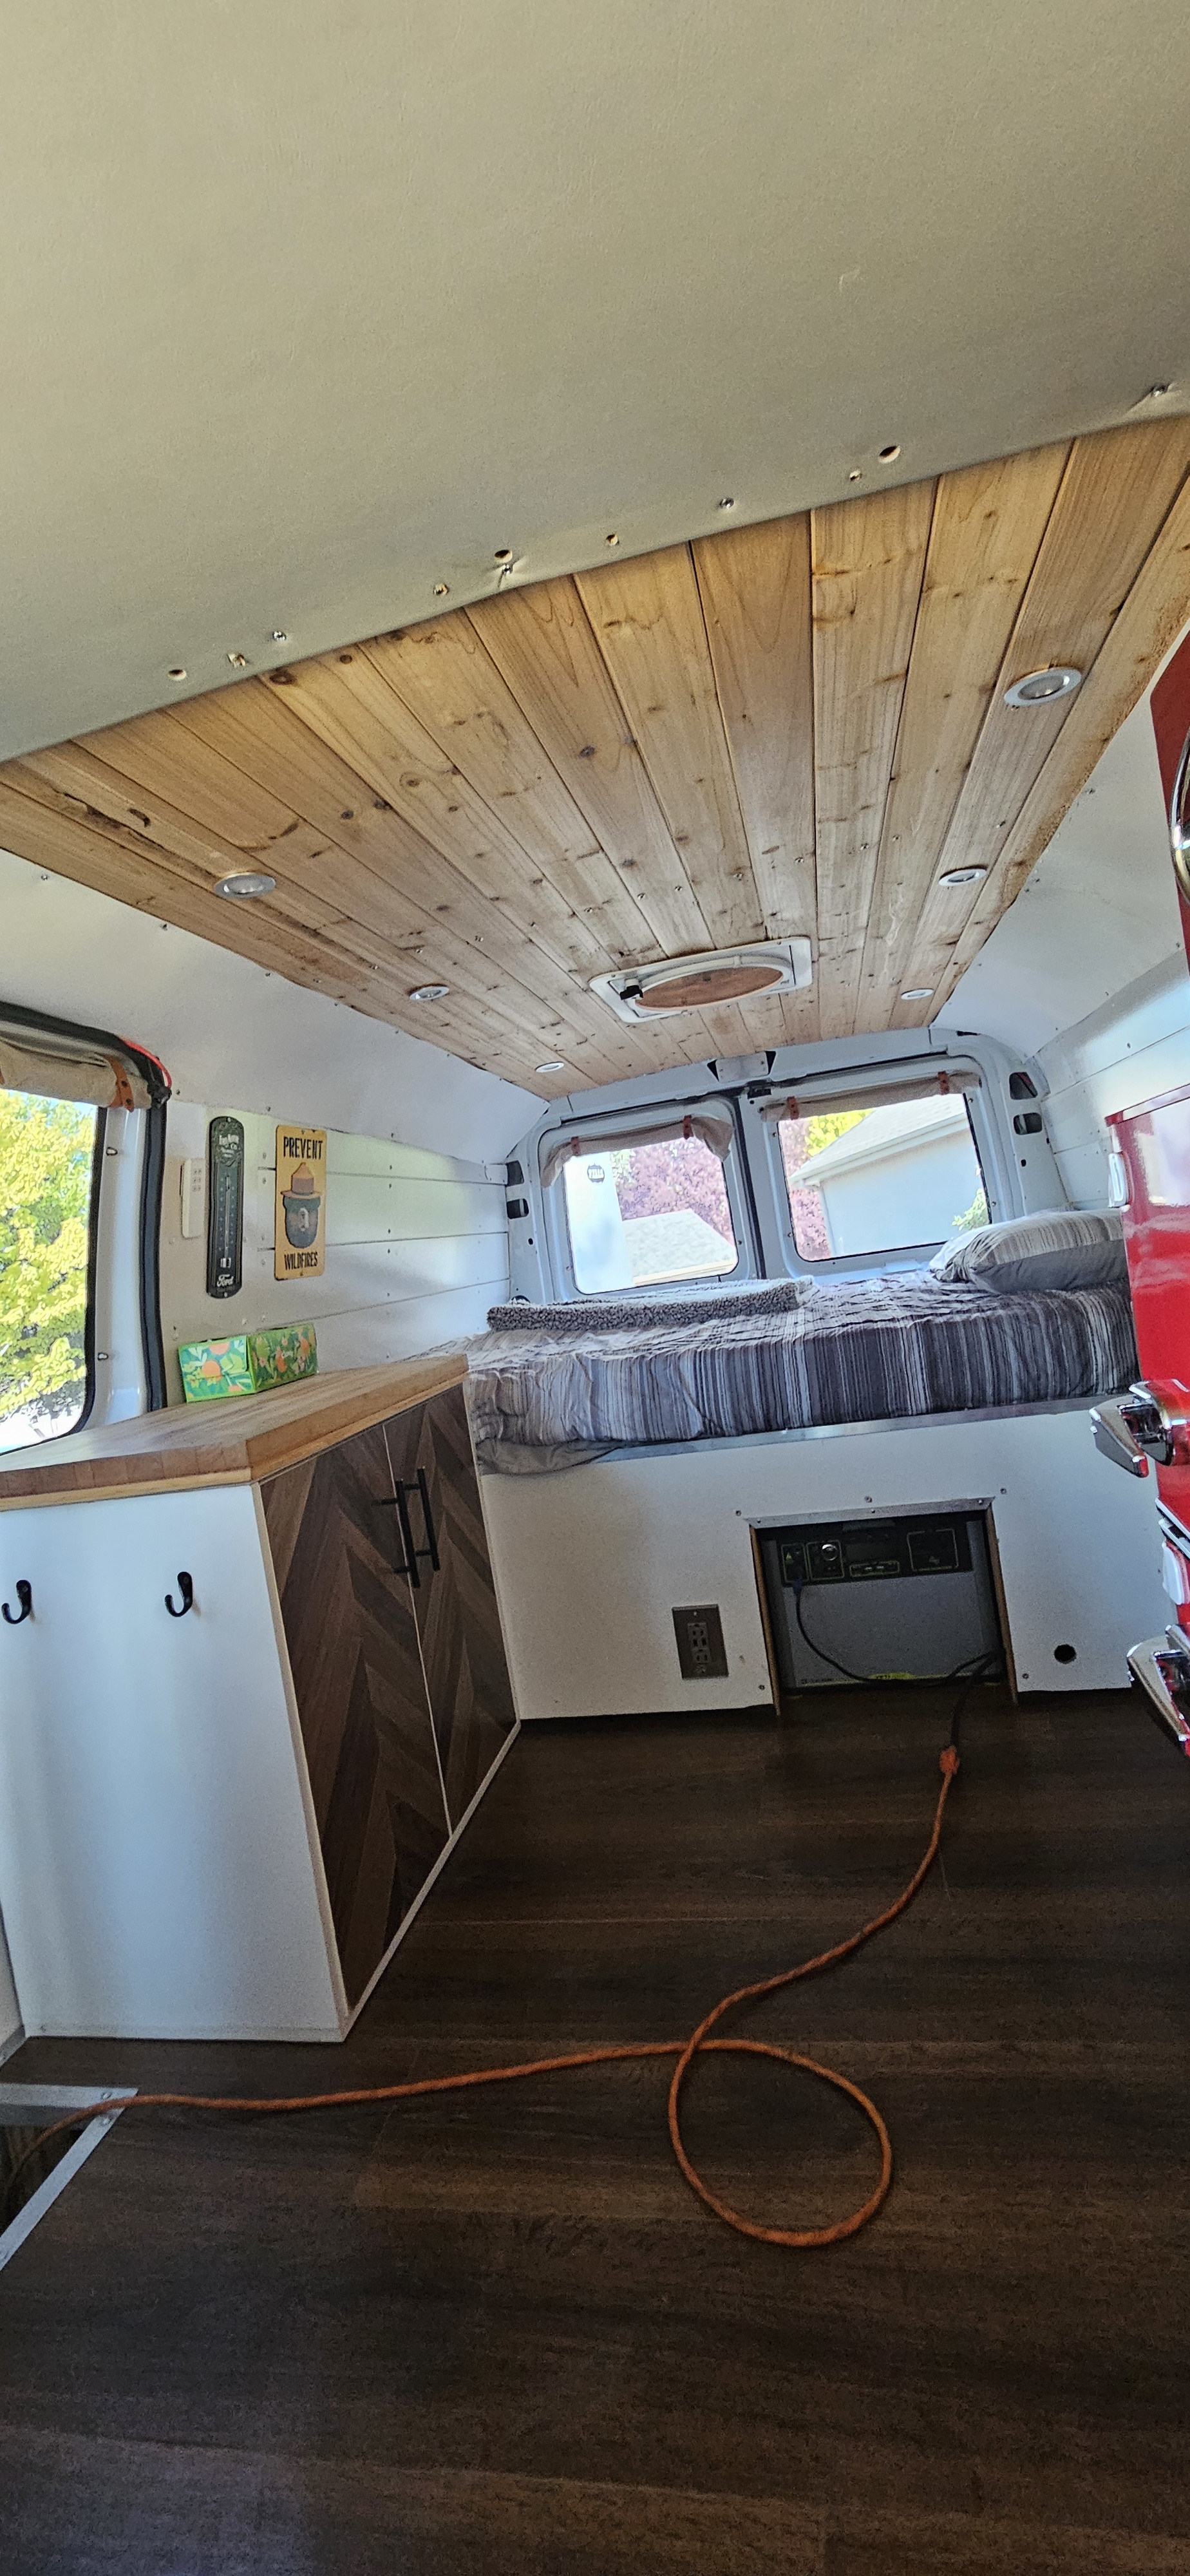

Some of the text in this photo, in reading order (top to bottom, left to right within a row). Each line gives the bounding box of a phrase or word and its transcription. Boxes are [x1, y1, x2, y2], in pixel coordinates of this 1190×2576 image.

[283, 1136, 323, 1160] PREVENT
[284, 1251, 318, 1270] WILDFIRES
[216, 1274, 234, 1287] Ford
